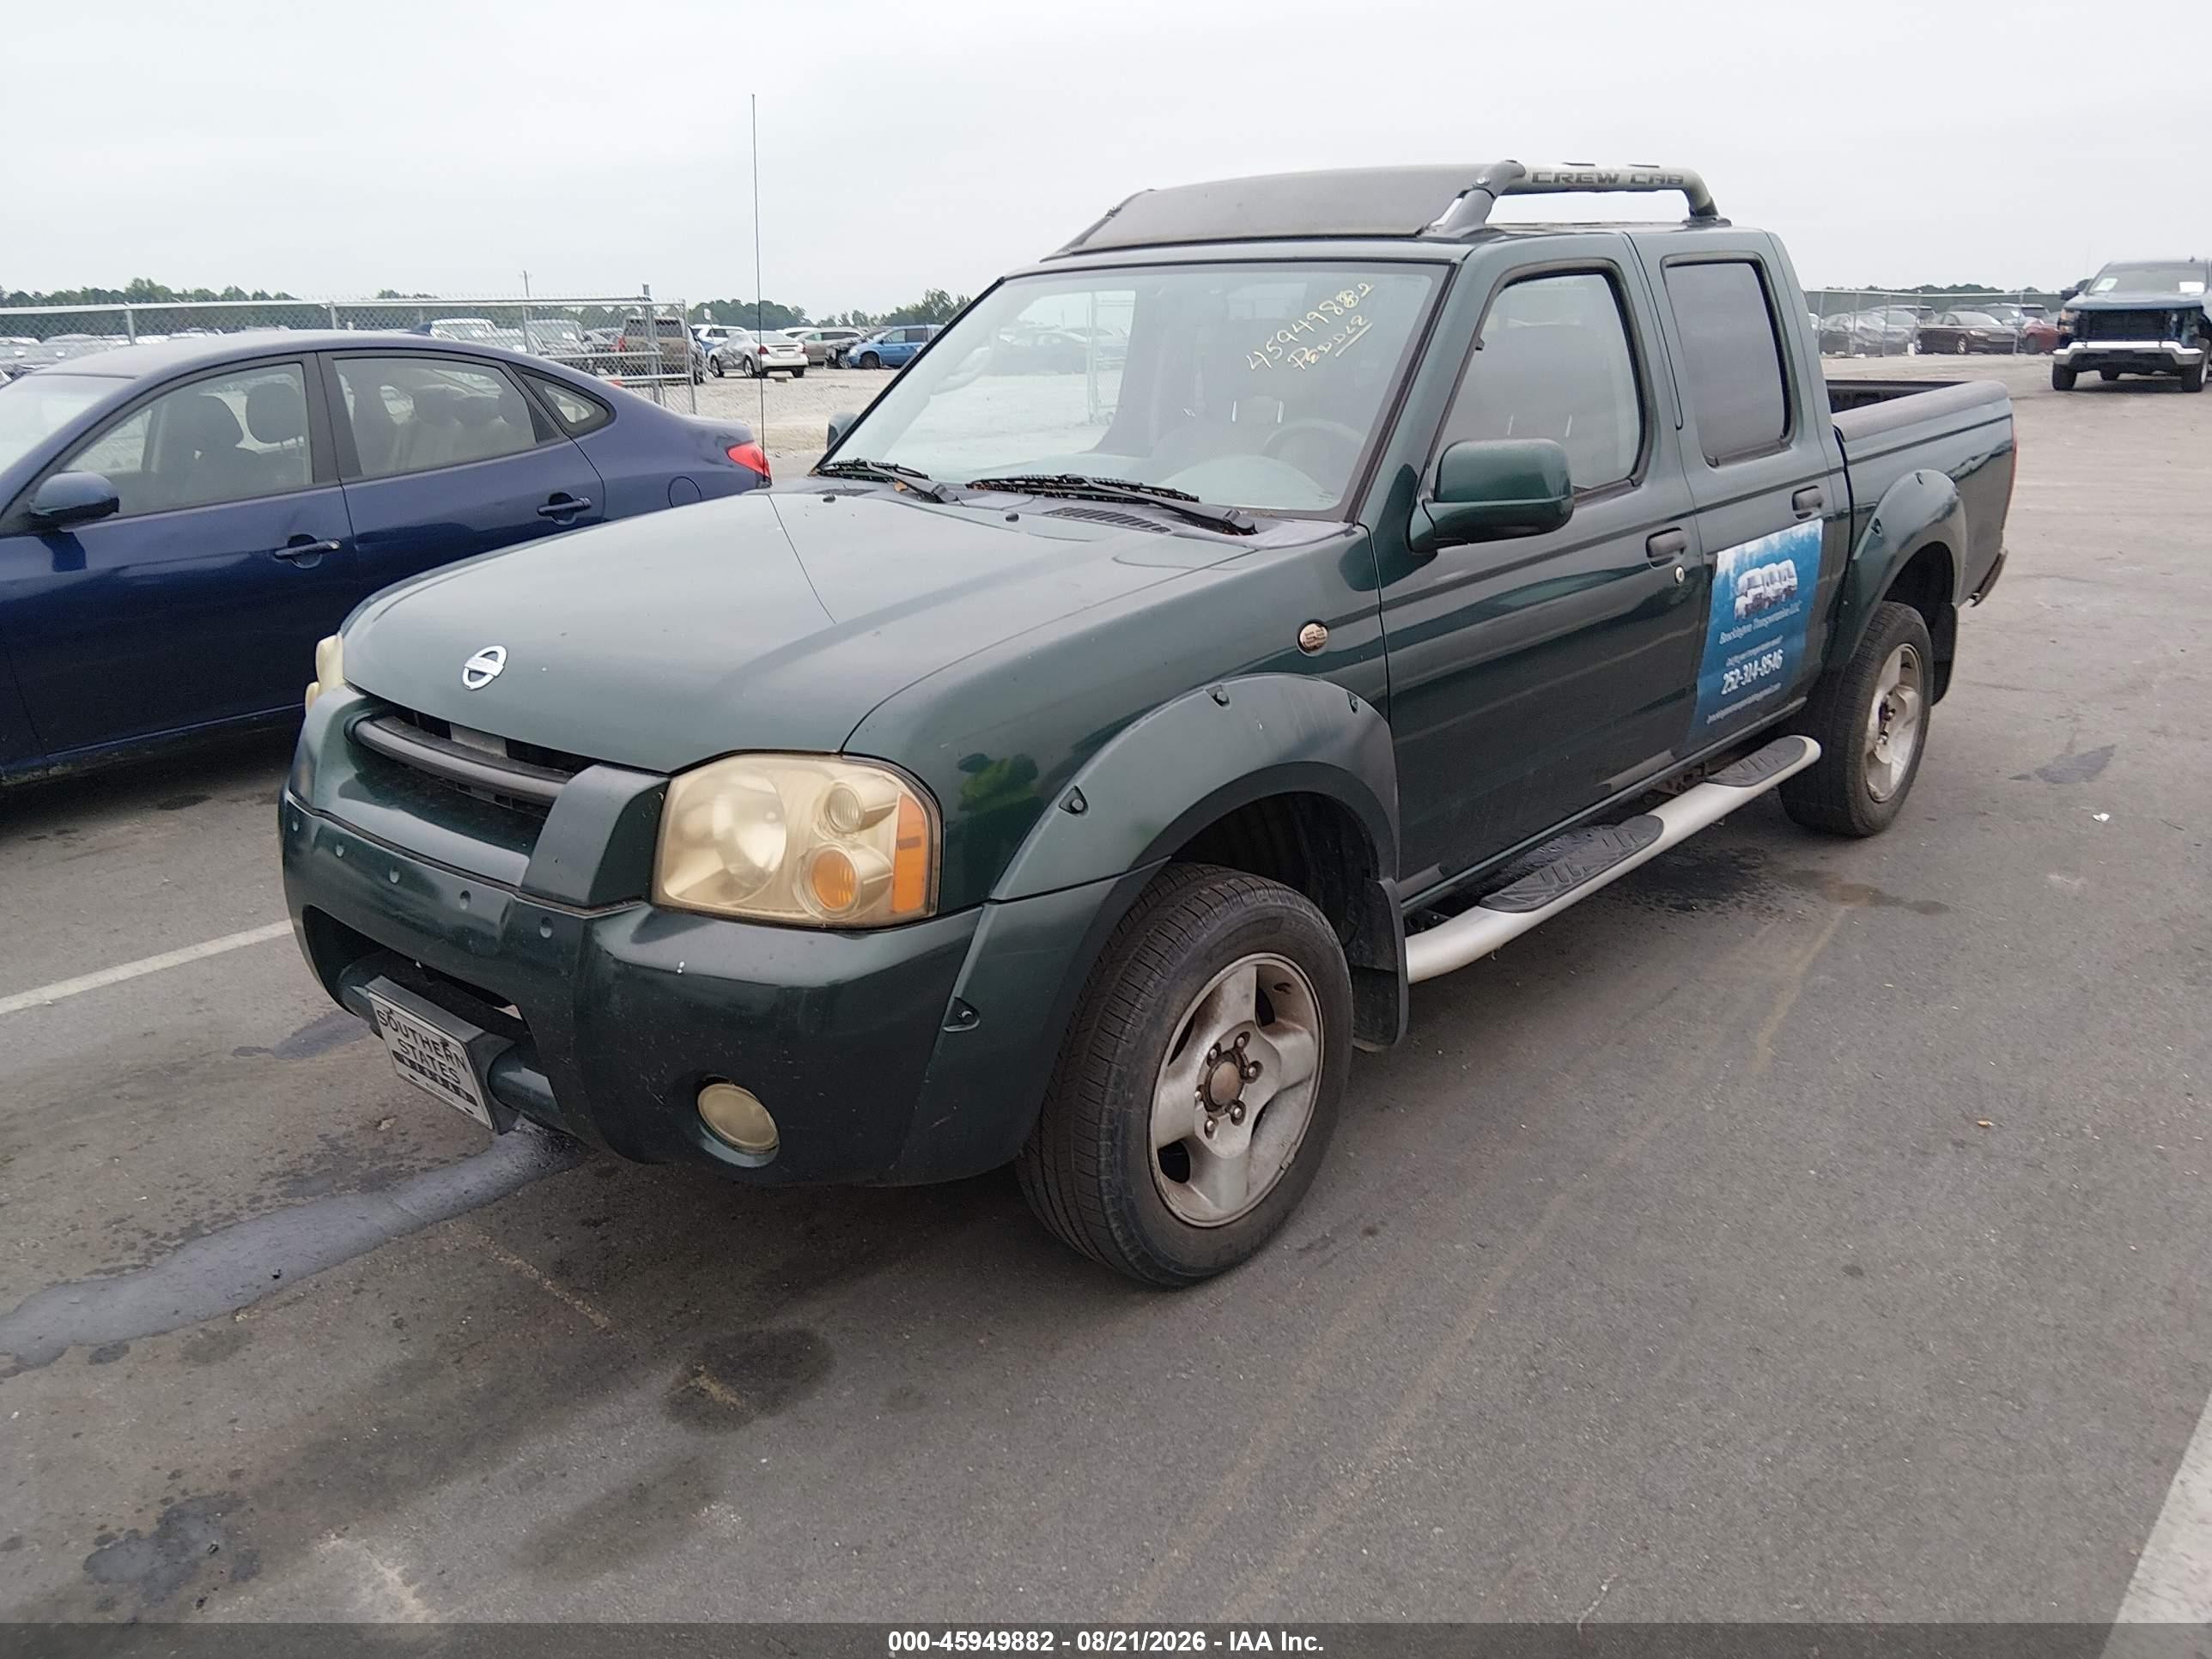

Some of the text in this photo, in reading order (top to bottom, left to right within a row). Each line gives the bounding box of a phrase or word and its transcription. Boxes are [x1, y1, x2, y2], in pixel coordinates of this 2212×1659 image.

[1531, 171, 1684, 185] CREW CAB
[1245, 283, 1375, 371] 45949882
[376, 1009, 468, 1073] SOUTHERN
[398, 1037, 461, 1085] STATES
